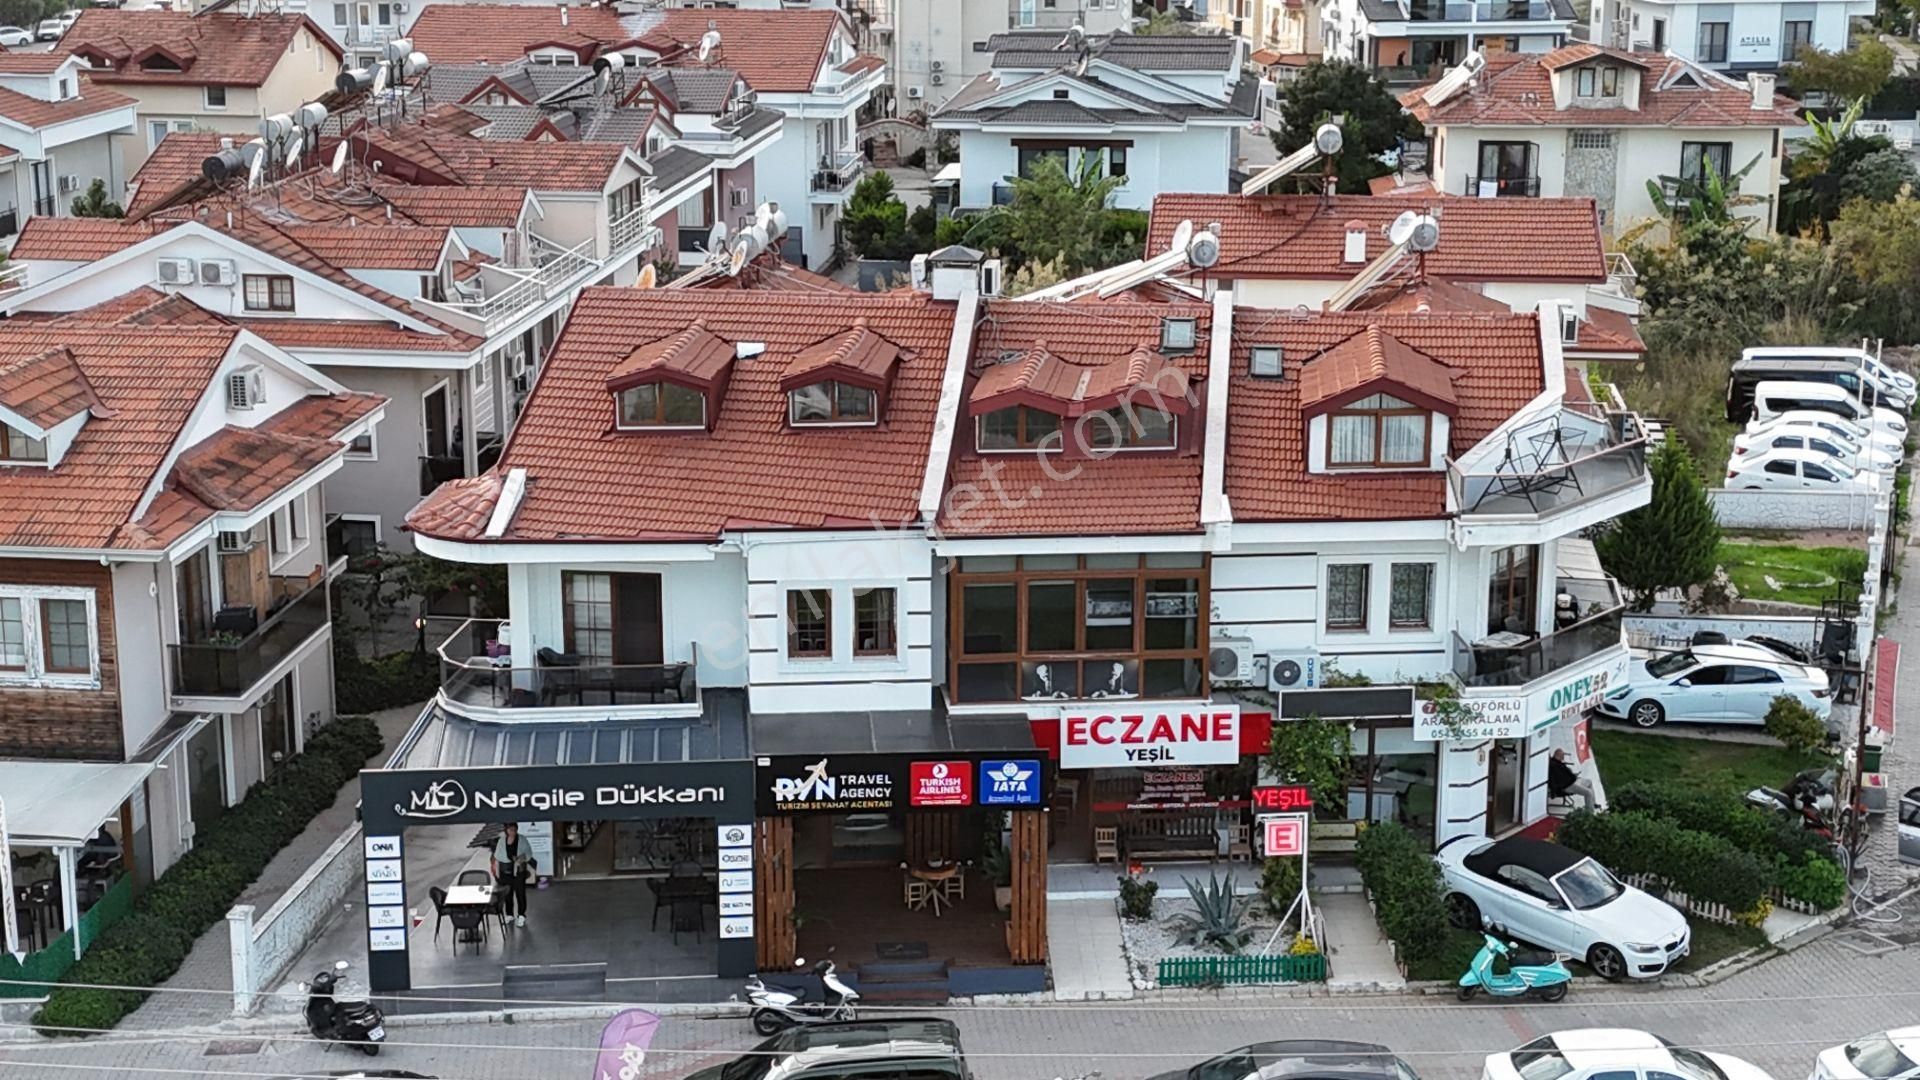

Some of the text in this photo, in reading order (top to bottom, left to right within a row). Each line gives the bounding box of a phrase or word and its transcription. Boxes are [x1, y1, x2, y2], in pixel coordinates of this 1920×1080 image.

[1561, 703, 1582, 720] RENT
[1589, 692, 1604, 706] CAR
[1421, 716, 1455, 727] ARA
[1066, 713, 1234, 746] ECZANE
[1497, 727, 1510, 737] 52
[1125, 745, 1175, 763] YEŞİL
[840, 774, 892, 785] TRAVEL
[920, 777, 961, 786] TURKISH
[775, 777, 836, 801] RYN
[919, 786, 961, 794] AIRLINES
[993, 781, 1028, 792] IATA
[474, 788, 585, 811] Nargile
[596, 784, 725, 806] Dükkanı
[840, 787, 892, 798] AGENCY
[811, 801, 849, 809] SEYAHAT
[1275, 826, 1292, 848] E
